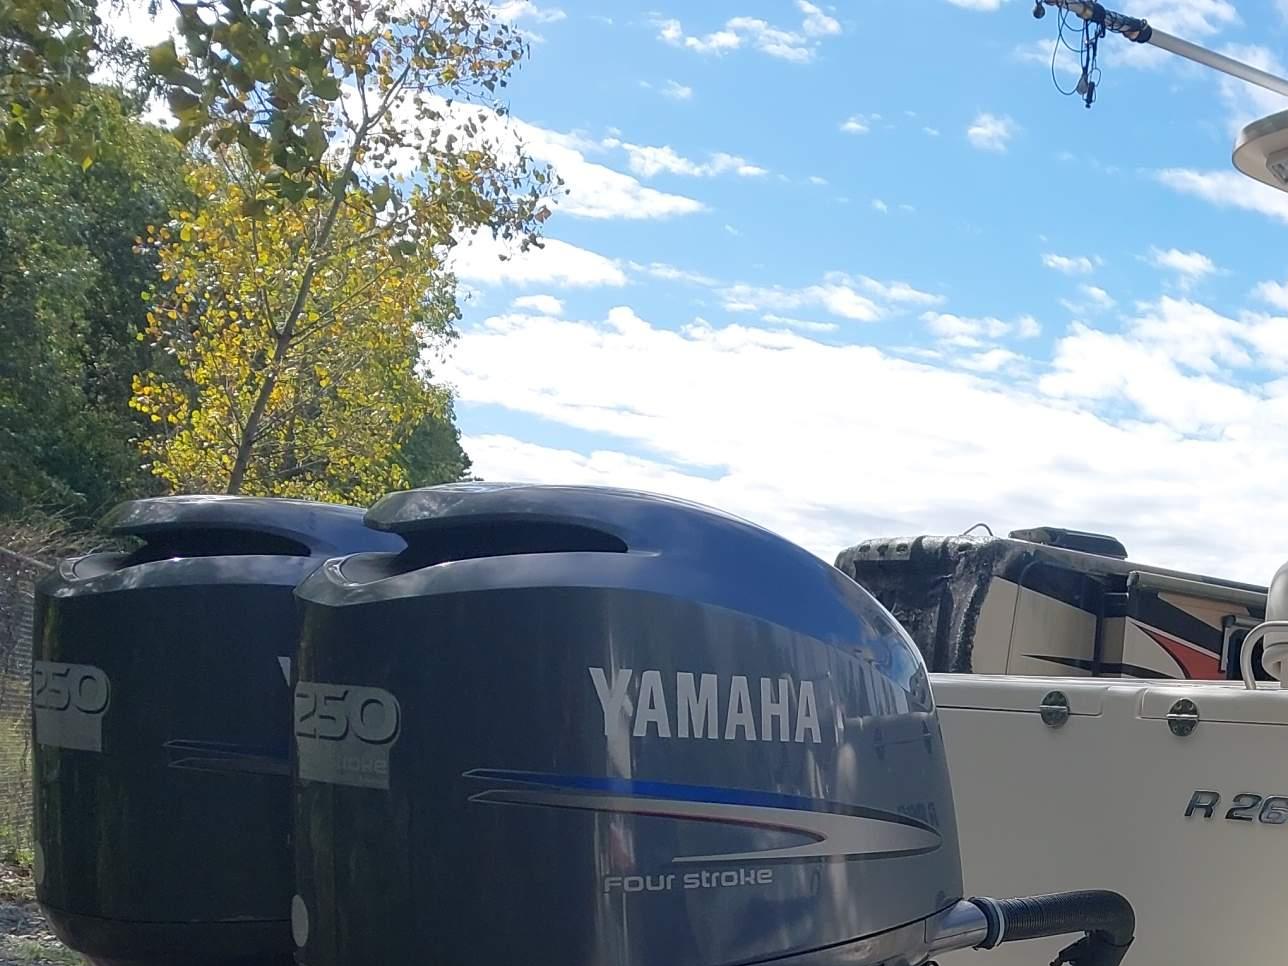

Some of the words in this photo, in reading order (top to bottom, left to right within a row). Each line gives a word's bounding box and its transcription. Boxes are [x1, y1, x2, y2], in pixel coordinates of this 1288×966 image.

[33, 664, 110, 714] 250
[588, 666, 822, 744] YAMAHA
[294, 688, 401, 745] 250
[1184, 789, 1221, 818] R
